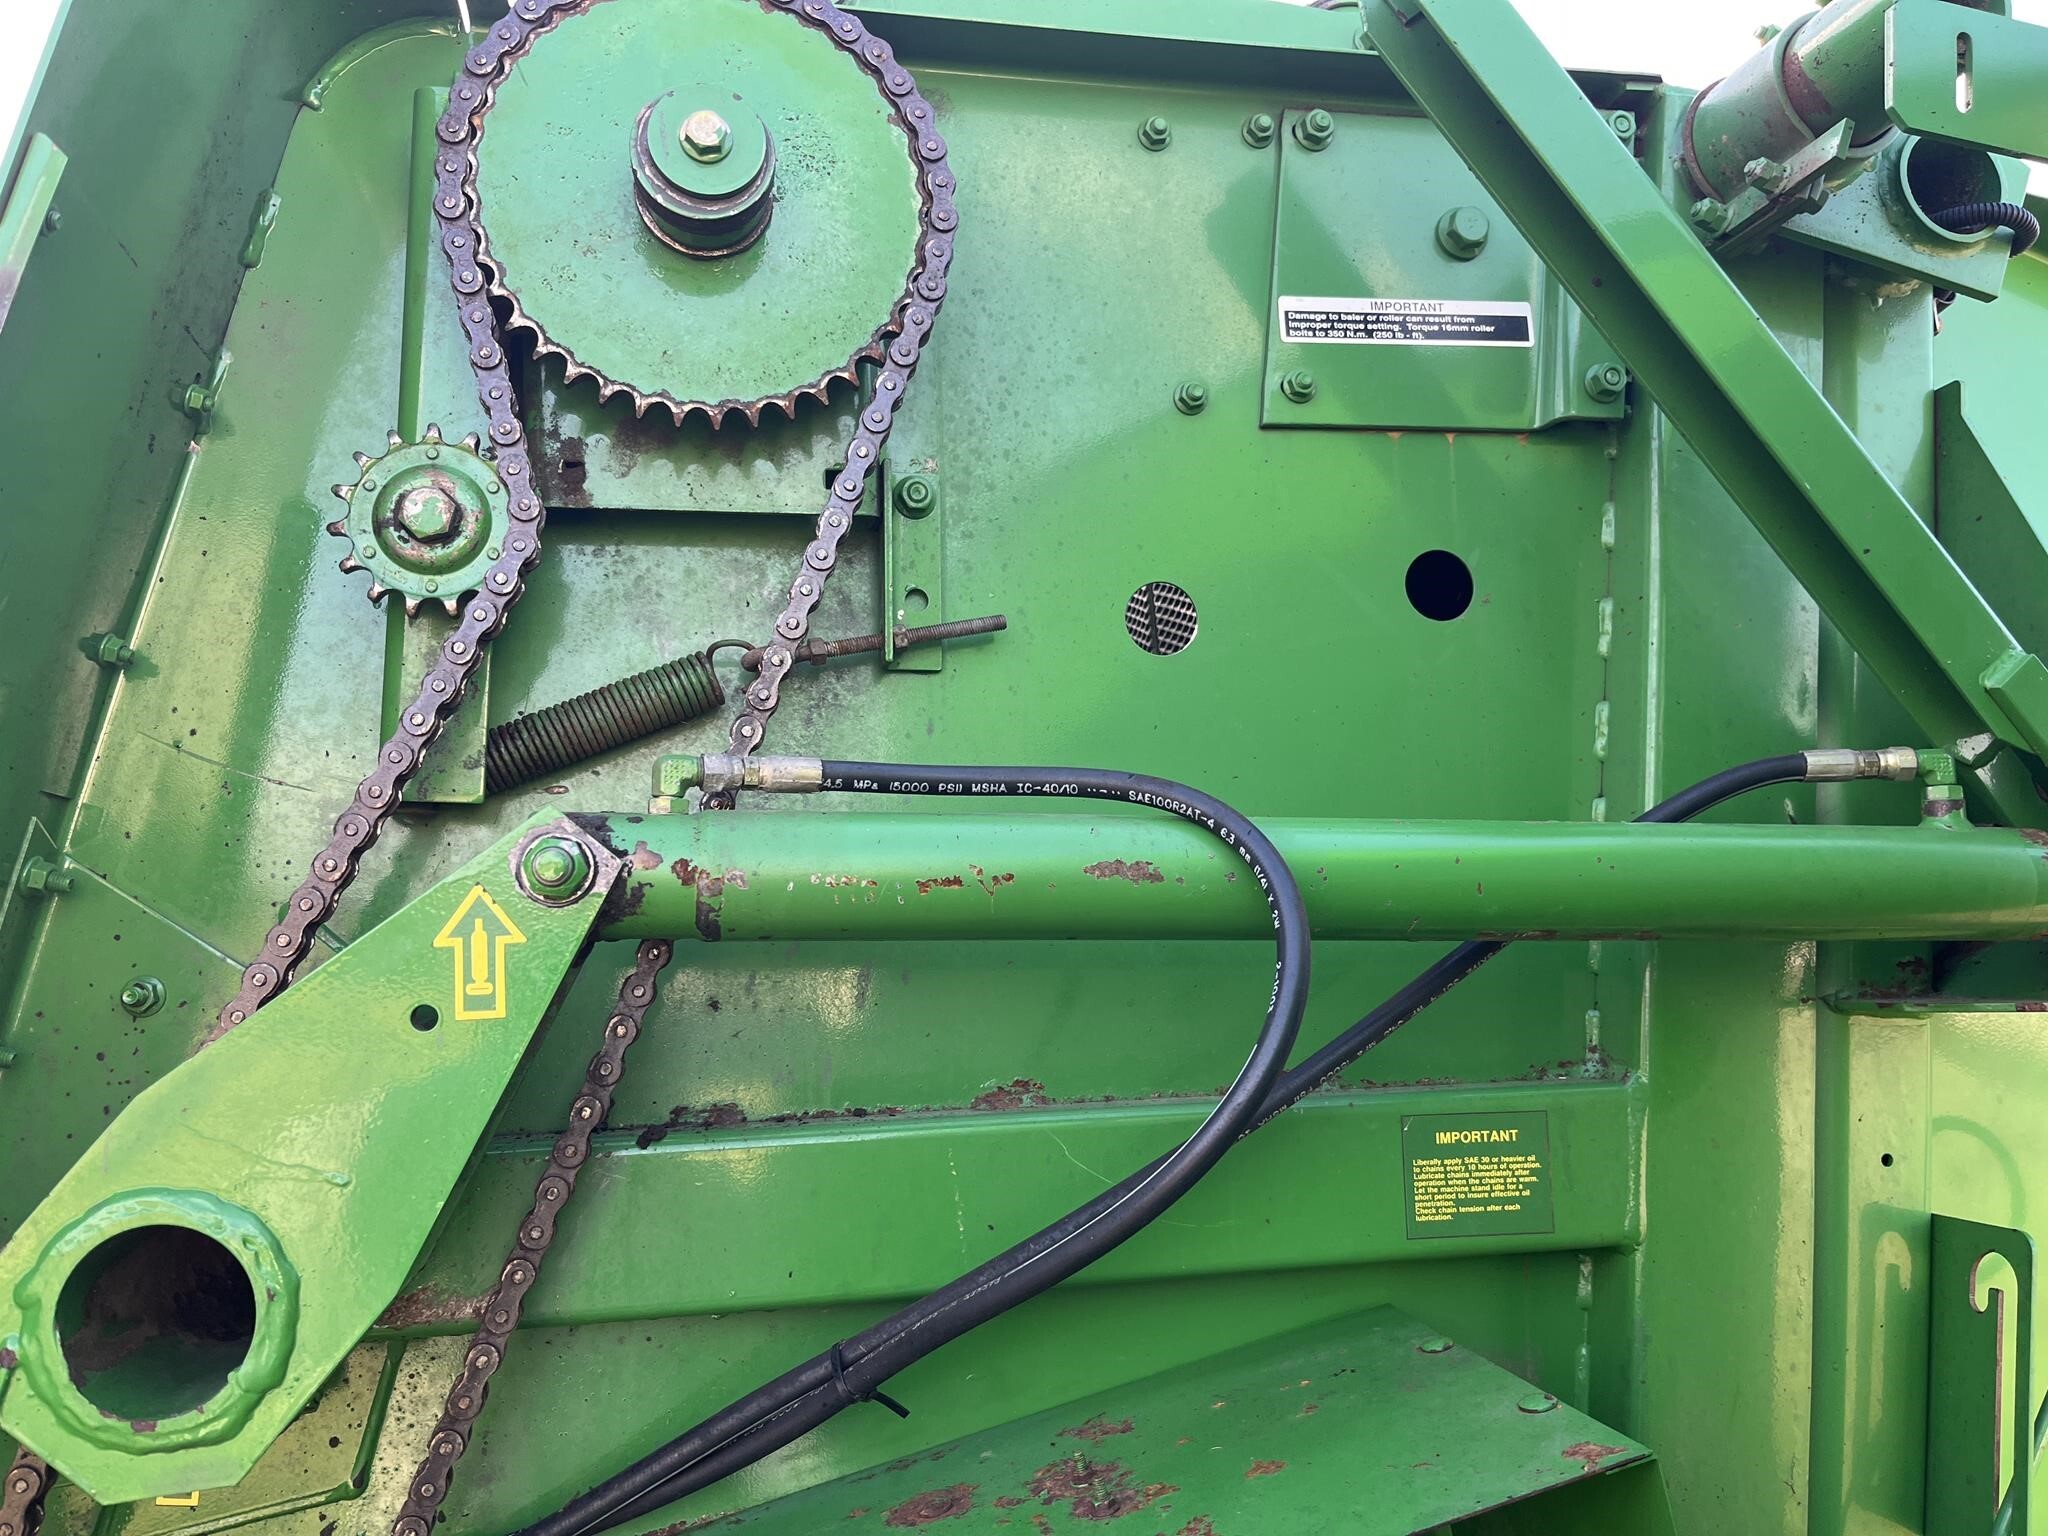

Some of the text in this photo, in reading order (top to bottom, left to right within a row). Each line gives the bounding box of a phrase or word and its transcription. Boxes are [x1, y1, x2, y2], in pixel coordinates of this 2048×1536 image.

[1370, 301, 1444, 312] IMPORTANT
[1288, 312, 1327, 321] Damage
[1341, 313, 1365, 321] baler
[1379, 314, 1404, 322] roller
[1405, 315, 1424, 323] can
[1425, 315, 1452, 323] result
[1453, 315, 1476, 324] from
[1333, 322, 1365, 331] torque
[1366, 322, 1402, 332] setting.
[1406, 323, 1440, 333] Torque
[1441, 324, 1469, 332] 16mm
[1470, 325, 1496, 333] roller
[1289, 329, 1314, 337] bolts
[1372, 331, 1393, 340] (250
[1395, 331, 1405, 339] lb
[853, 779, 879, 790] MPa
[971, 783, 1008, 793] MSHA
[1016, 783, 1079, 794] IC-40/10
[1128, 790, 1215, 830] SAE100R2AT-4
[1220, 827, 1236, 845] 6.3
[1239, 846, 1251, 864] mm
[1435, 1129, 1518, 1145] IMPORTANT
[1413, 1158, 1442, 1167] Liberally
[1443, 1157, 1463, 1165] apply
[1464, 1156, 1479, 1164] SAE
[1422, 1165, 1445, 1173] chains
[1508, 1161, 1542, 1169] operation.
[1413, 1172, 1445, 1180] Lubricate
[1447, 1171, 1470, 1179] chains
[1471, 1169, 1513, 1177] immediately
[1413, 1179, 1446, 1188] operation
[1481, 1176, 1505, 1184] chains
[1414, 1186, 1426, 1194] Let
[1440, 1184, 1469, 1192] machine
[1414, 1193, 1433, 1201] short
[1434, 1192, 1456, 1201] period
[1490, 1189, 1520, 1197] effective
[1414, 1200, 1456, 1208] penetration.
[1415, 1207, 1437, 1215] Check
